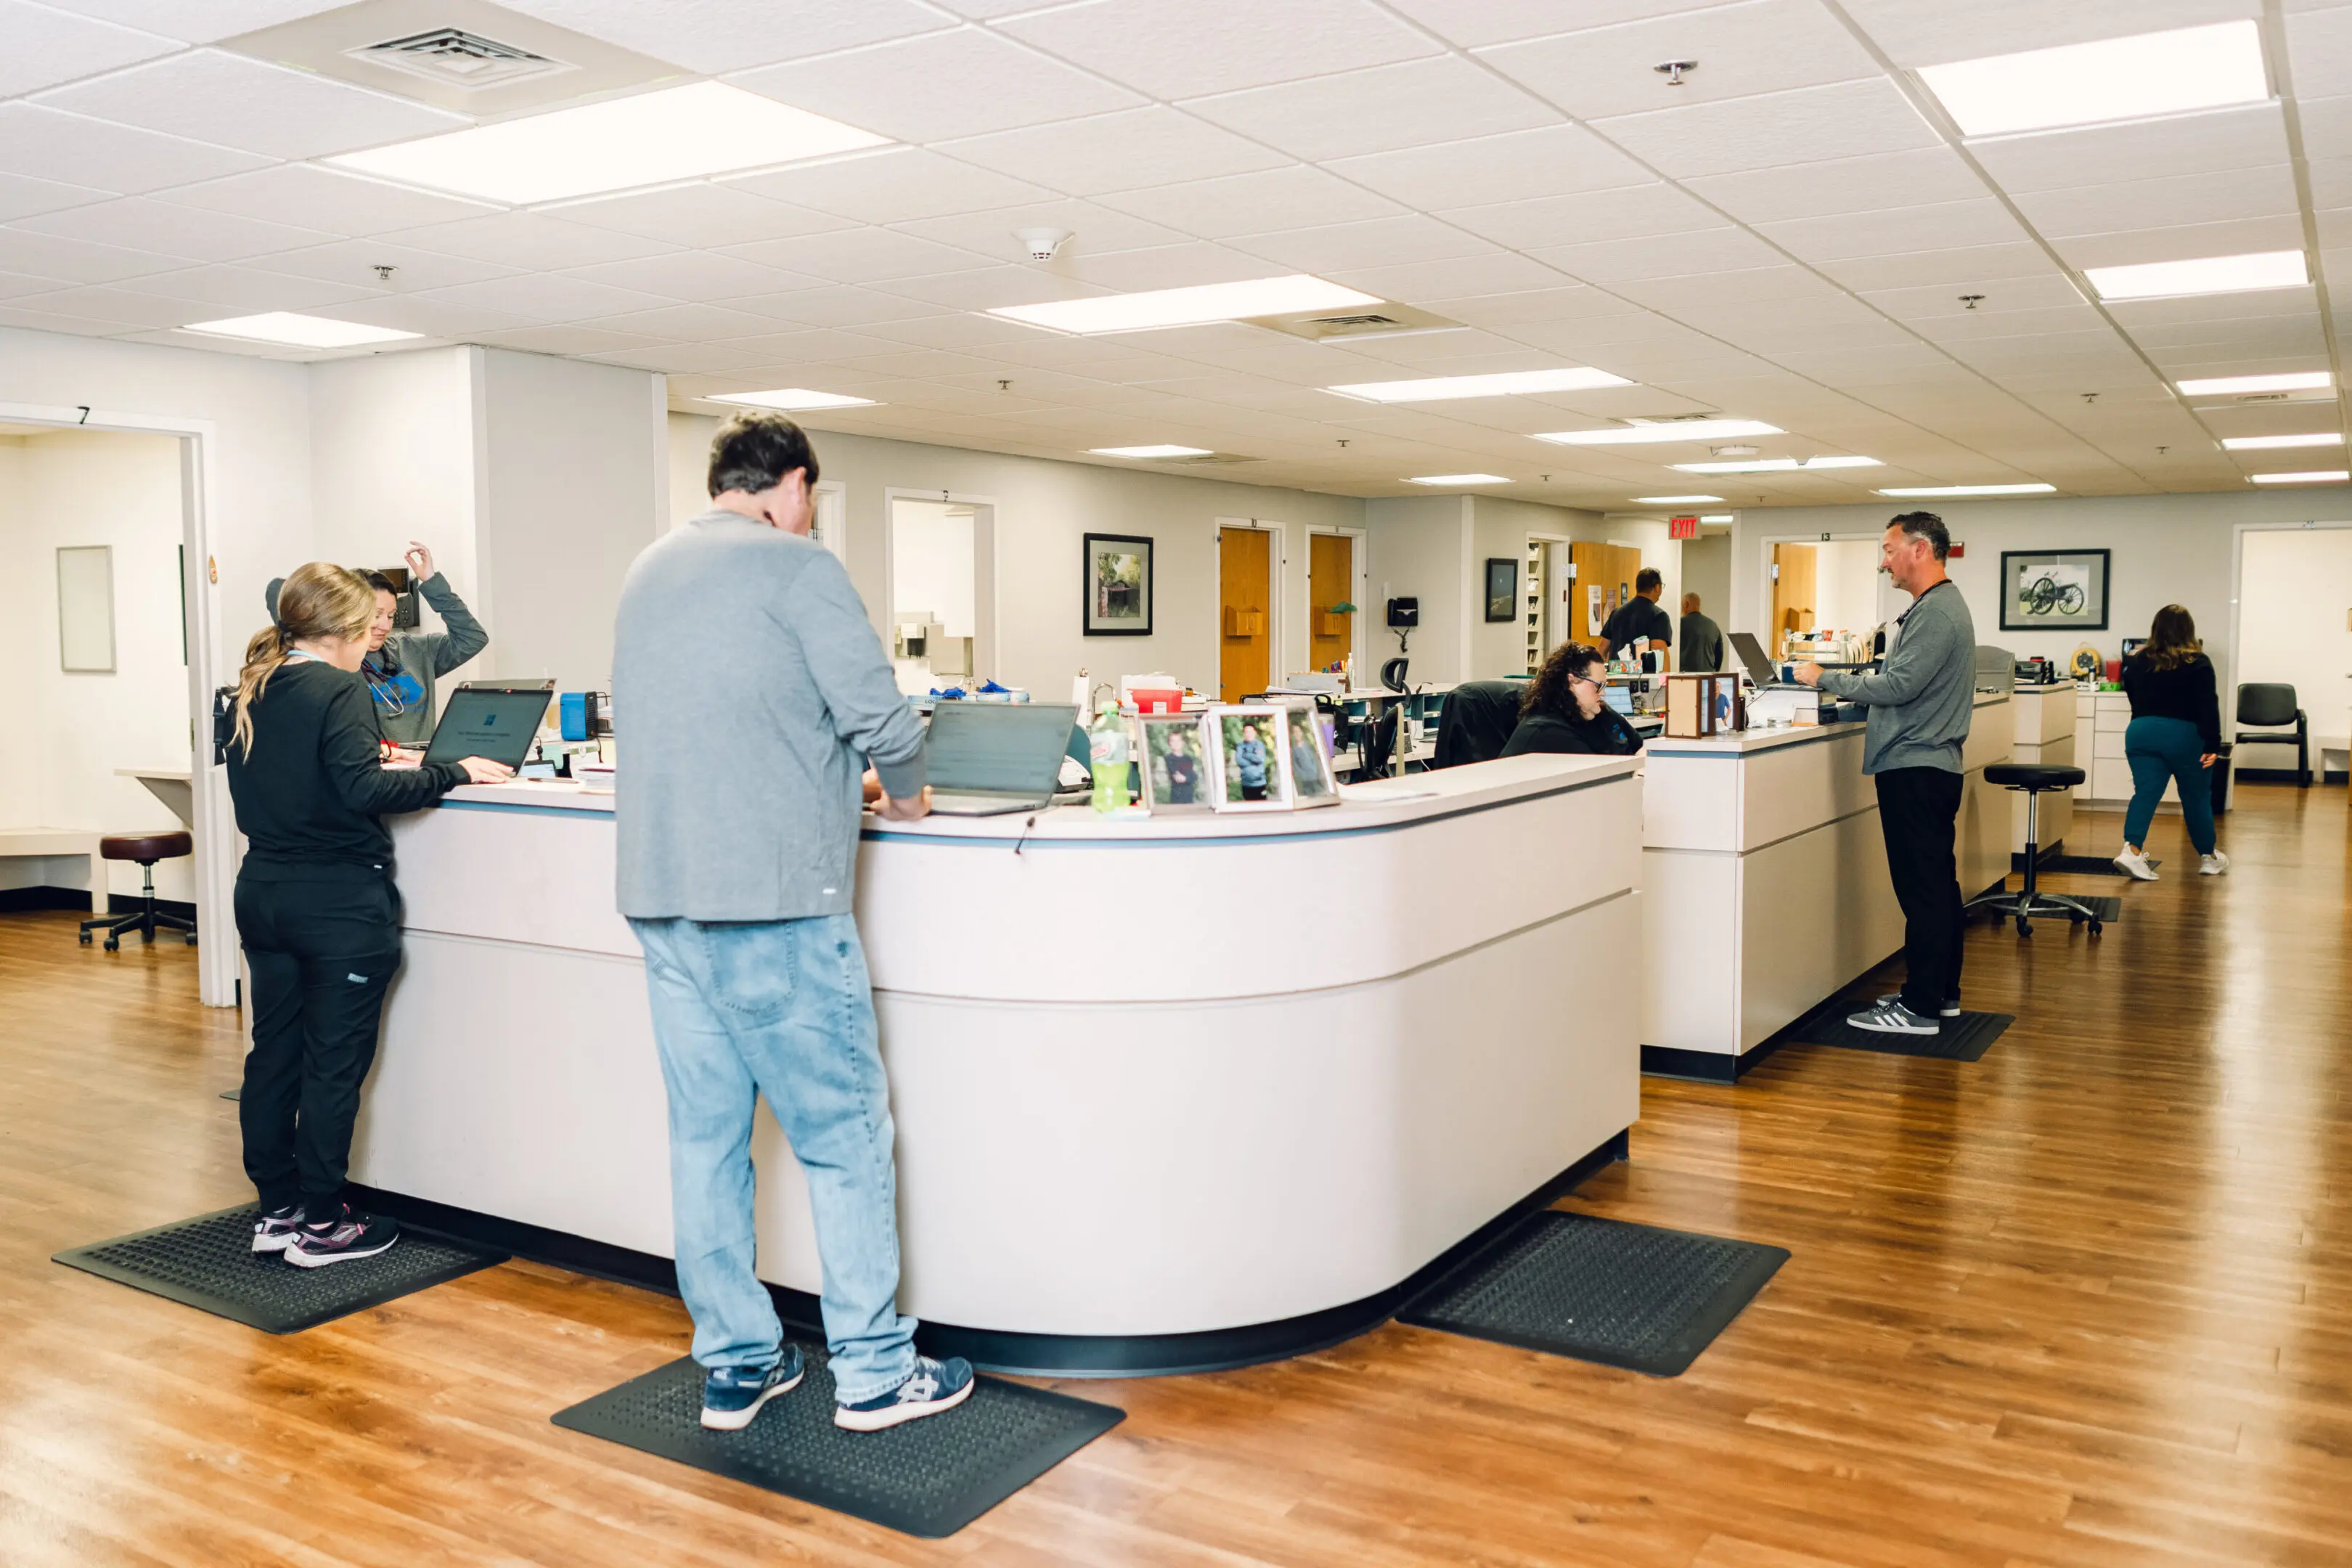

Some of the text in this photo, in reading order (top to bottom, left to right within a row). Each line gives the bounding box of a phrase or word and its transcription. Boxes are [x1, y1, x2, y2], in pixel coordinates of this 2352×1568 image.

[77, 406, 91, 425] 7
[1251, 518, 1257, 528] 10
[1671, 518, 1697, 538] EXIT
[1821, 532, 1831, 542] 13
